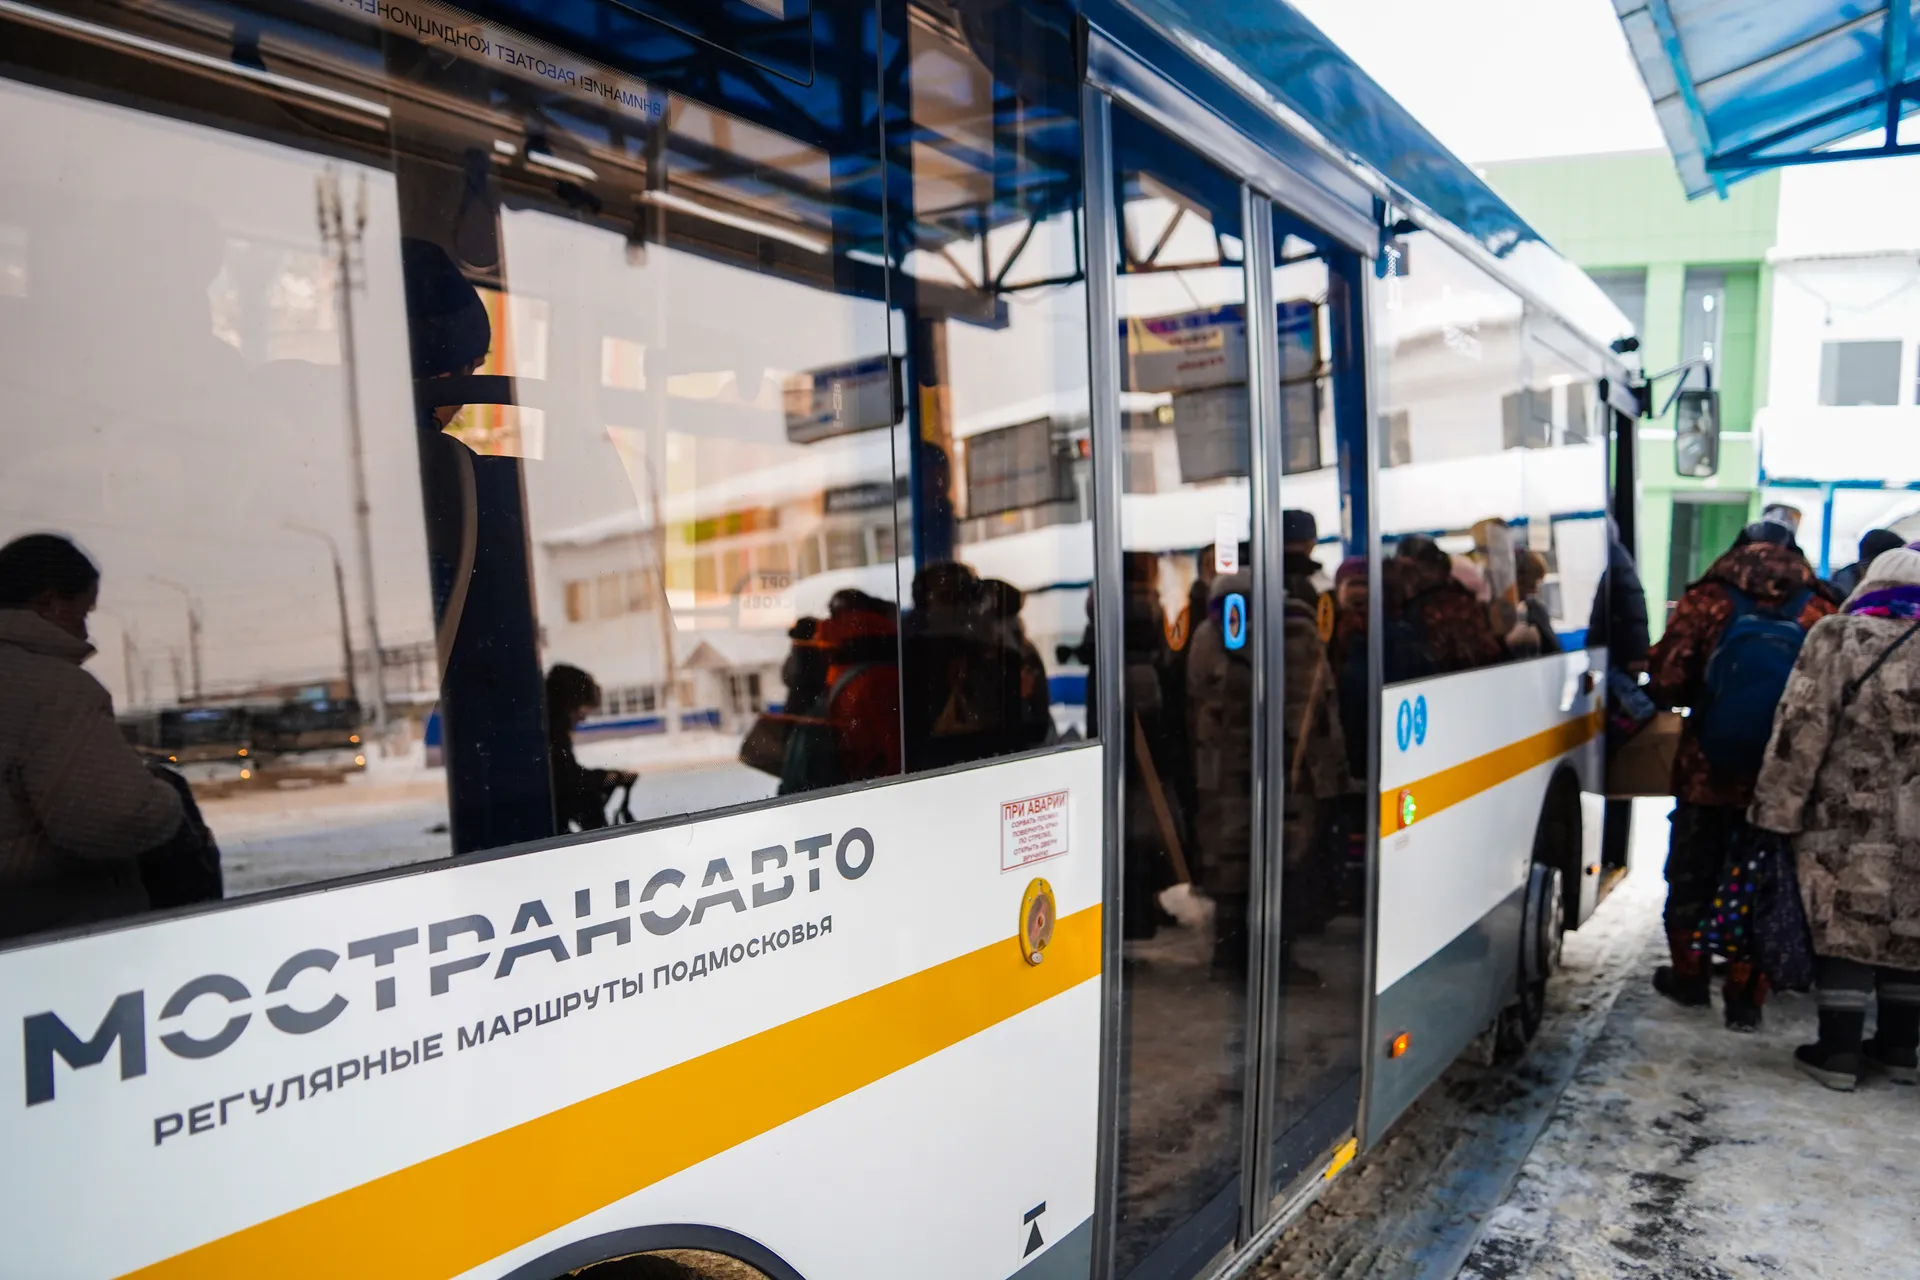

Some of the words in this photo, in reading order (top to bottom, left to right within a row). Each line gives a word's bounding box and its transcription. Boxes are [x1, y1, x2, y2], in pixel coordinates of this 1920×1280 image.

[1005, 803, 1025, 820] ПРИ
[1027, 794, 1065, 815] АВАРИИ
[23, 826, 875, 1107] МОСТРАНСАВТО
[153, 1032, 444, 1147] РЕГУЛЯРНЫЕ
[457, 972, 644, 1051] МАРШРУТЫ
[653, 914, 833, 990] ПОДМОСКОВЬЯ
